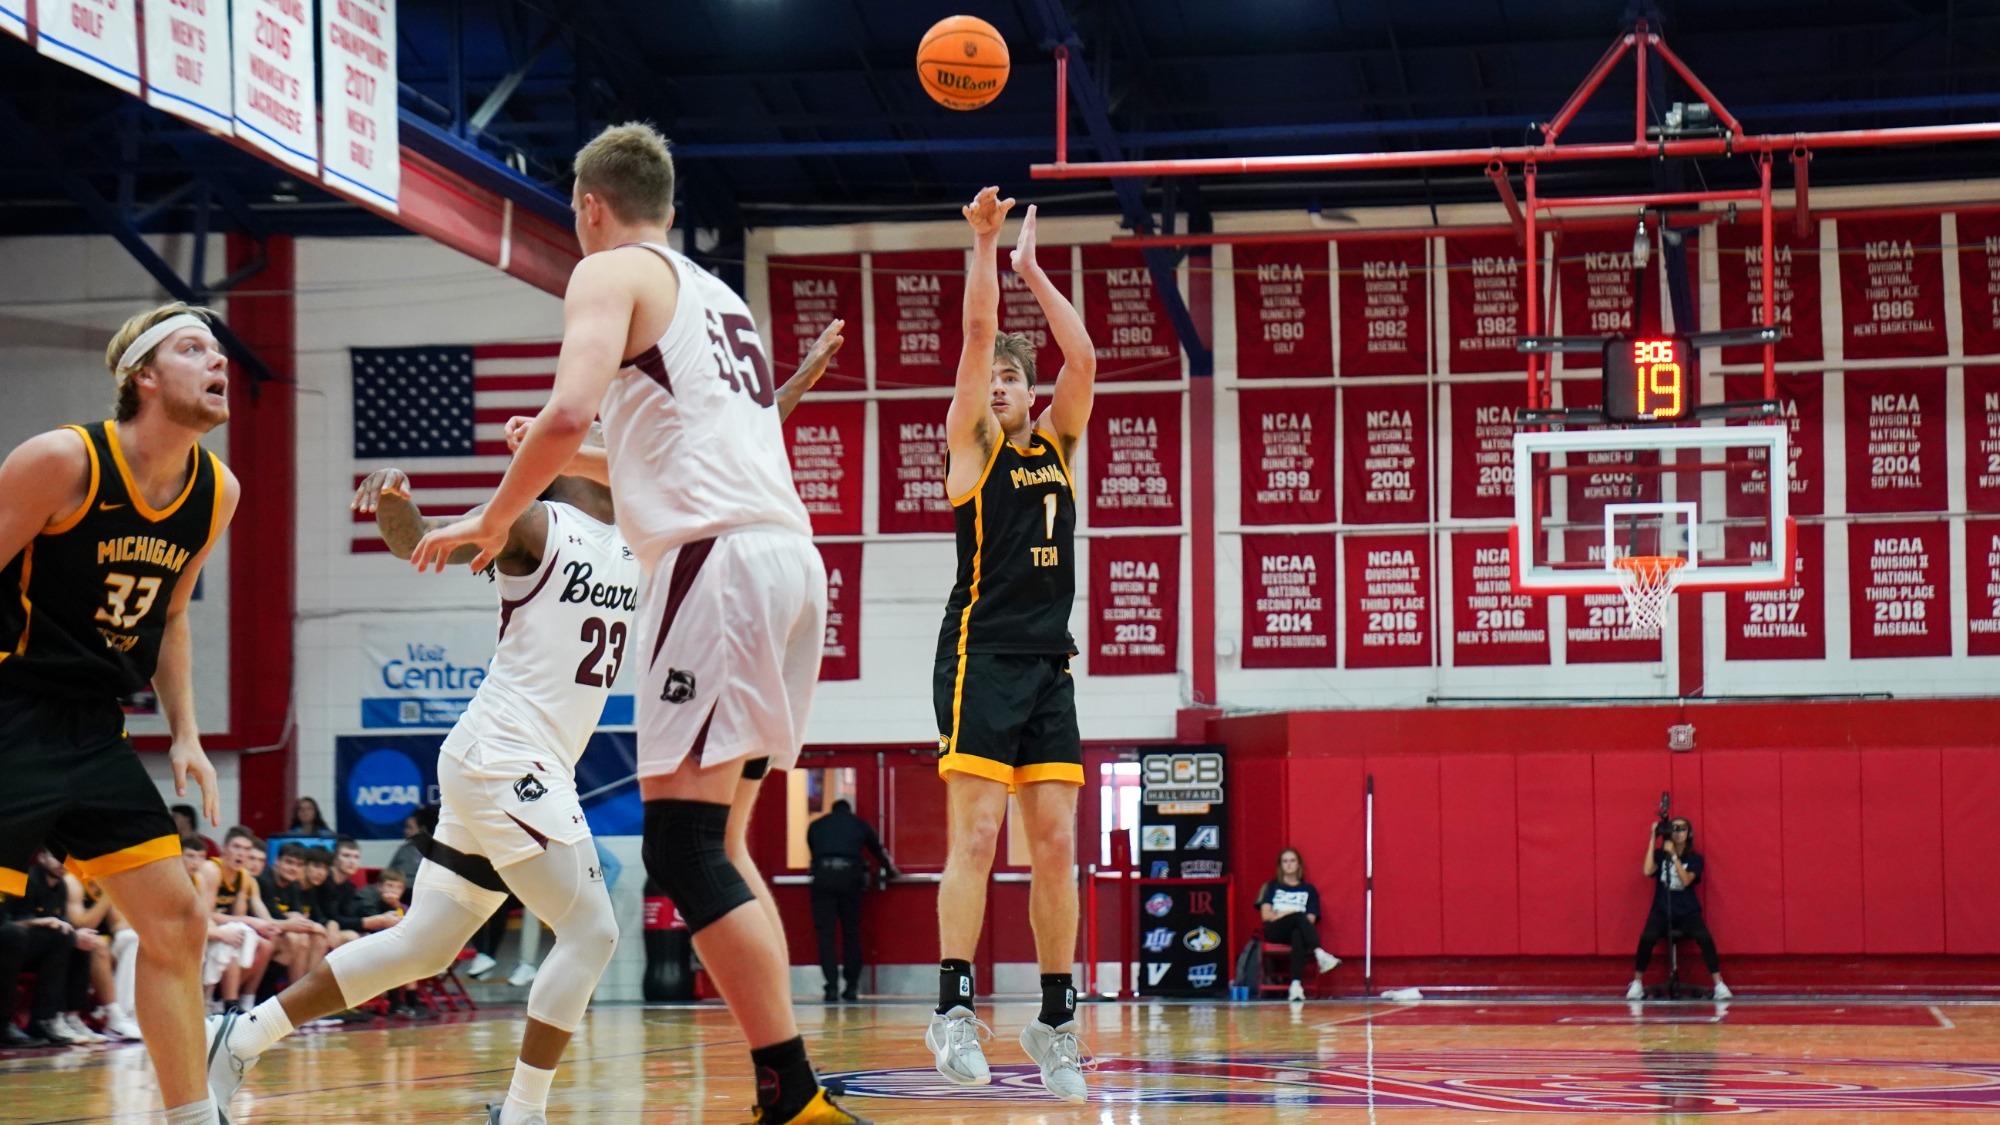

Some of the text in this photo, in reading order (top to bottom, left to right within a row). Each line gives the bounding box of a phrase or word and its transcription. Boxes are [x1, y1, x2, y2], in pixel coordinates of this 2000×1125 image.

[255, 10, 291, 60] 2016
[345, 63, 376, 107] 2017
[937, 69, 996, 90] Wilson
[1865, 240, 1914, 260] NCAA
[1363, 261, 1409, 279] NCAA
[1472, 257, 1518, 275] NCAA
[1585, 253, 1632, 271] NCAA
[1868, 262, 1900, 275] DIVISION
[1106, 269, 1152, 286] NCAA
[1257, 264, 1304, 281] NCAA
[1871, 274, 1911, 287] NATIONAL
[792, 280, 838, 297] NCAA
[895, 275, 941, 293] NCAA
[1590, 285, 1627, 296] NATIONAL
[1865, 285, 1919, 300] THIRD PLACE
[1475, 290, 1515, 301] NATIONAL
[1872, 301, 1913, 321] 1986
[1368, 321, 1407, 338] 1982
[1477, 317, 1517, 335] 1982
[1592, 312, 1631, 330] 1984
[1854, 319, 1934, 336] MEN'S BASKETBALL
[1112, 327, 1152, 344] 1980
[1263, 322, 1304, 340] 1980
[901, 333, 940, 351] 1979
[1274, 342, 1294, 354] GOLF
[1367, 341, 1407, 353] BASEBALL
[1634, 341, 1673, 363] 3:06
[1638, 363, 1680, 416] 19
[1871, 394, 1920, 413] NCAA
[1108, 417, 1158, 434] NCAA
[1262, 413, 1312, 431] NCAA
[1367, 411, 1413, 428] NCAA
[1870, 414, 1909, 428] DIVISION
[796, 426, 841, 443] NCAA
[900, 423, 946, 441] NCAA
[1871, 428, 1918, 441] NATIONAL
[1869, 441, 1921, 456] RUNNER UP
[1872, 455, 1921, 475] 2004
[1101, 477, 1167, 494] 1998-99
[1267, 471, 1310, 489] 1999
[1371, 471, 1410, 488] 2001
[1871, 475, 1922, 489] SOFTBALL
[799, 482, 838, 499] 1994
[903, 482, 944, 499] 1998
[1299, 490, 1321, 501] GOLF
[1366, 489, 1415, 502] MEN'S GOLF
[1043, 493, 1057, 539] 1
[1874, 537, 1923, 554] NCAA
[98, 536, 189, 574] MICHIGAN
[1368, 551, 1415, 567] NCAA
[1476, 548, 1510, 564] NCA
[1871, 555, 1929, 570] DIVISION II
[1110, 561, 1160, 579] NCAA
[1262, 556, 1316, 572] NCAA
[1262, 573, 1305, 585] DIVISION
[1365, 568, 1409, 581] DIVISION
[1873, 570, 1925, 585] NATIONAL
[1267, 586, 1311, 597] NATIONAL
[1368, 583, 1416, 596] NATIONAL
[94, 572, 162, 629] 33
[1257, 598, 1322, 611] SECOND PLACE
[1361, 597, 1425, 611] THIRD PLACE
[1468, 595, 1533, 609] THIRD PLACE
[1477, 610, 1525, 629] 2016
[1750, 604, 1799, 622] 2017
[1875, 602, 1926, 620] 2018
[1266, 614, 1312, 632] 2014
[1369, 612, 1417, 631] 2016
[1874, 621, 1928, 636] BASEBALL
[1115, 624, 1157, 642] 2013
[1363, 632, 1423, 646] MEN'S GOLF
[1457, 629, 1545, 644] MEN'S SWIMMING
[1568, 628, 1610, 641] WOMEN'S
[1743, 623, 1808, 638] VOLLEYBALL
[1253, 636, 1278, 648] MEN'S
[407, 643, 444, 662] Visit
[575, 617, 627, 689] 23
[383, 660, 492, 689] Centra
[1143, 753, 1223, 783] SCB
[356, 785, 420, 805] NCAA
